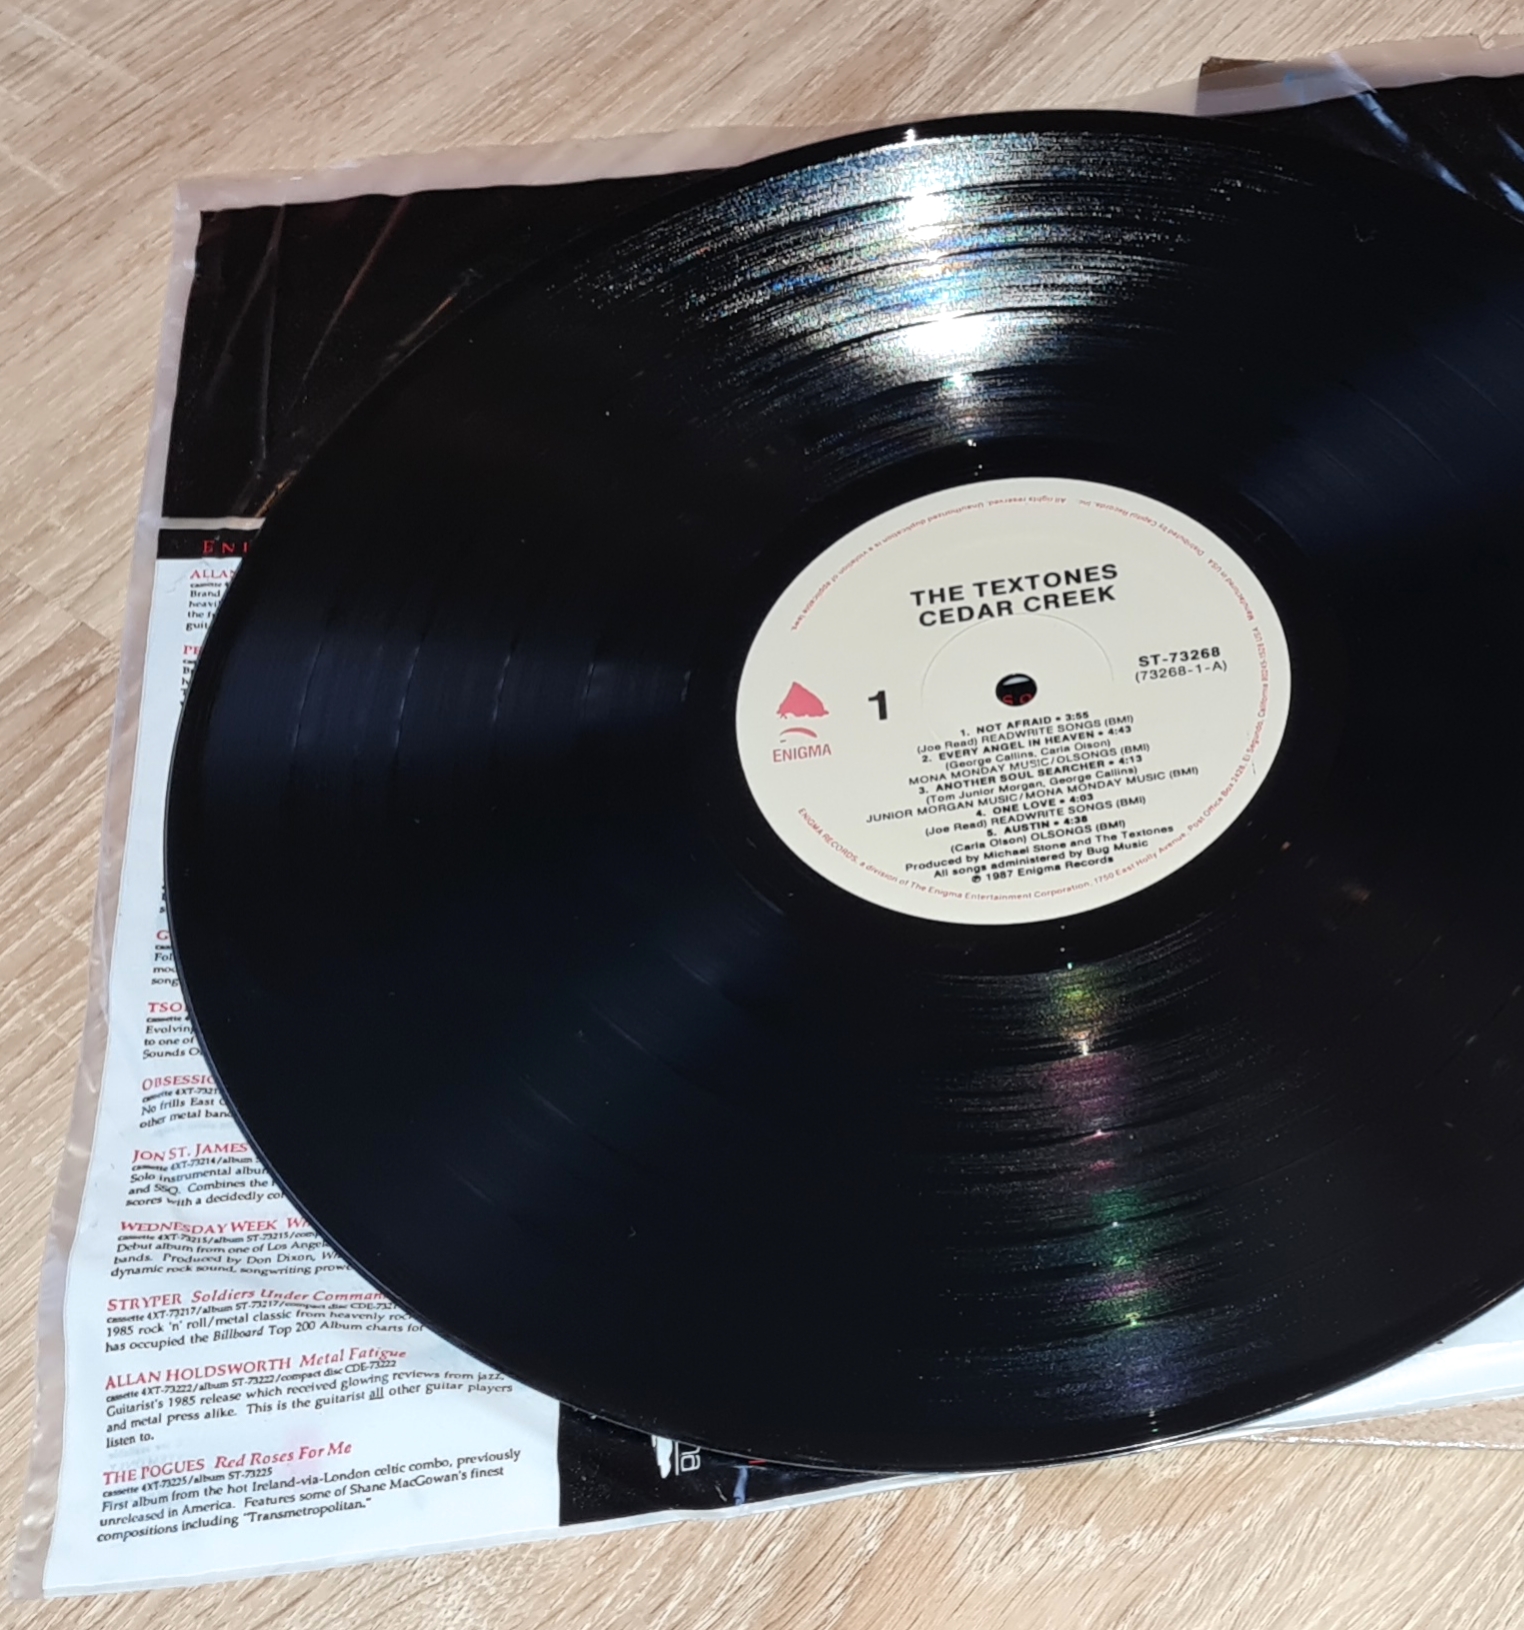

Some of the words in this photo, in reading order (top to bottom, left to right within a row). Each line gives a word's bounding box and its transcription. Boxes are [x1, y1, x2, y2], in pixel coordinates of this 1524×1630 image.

[910, 585, 964, 606] THE
[973, 563, 1117, 597] TEXTONES
[919, 600, 1013, 627] CEDAR
[1023, 585, 1114, 612] CREEK
[1135, 660, 1227, 683] (73268-1-A)
[1138, 646, 1220, 667] ST-73268
[868, 690, 887, 721] 1
[960, 728, 970, 737] 1.
[976, 722, 1002, 736] NOT
[1006, 715, 1052, 733] AFRAID
[1065, 710, 1090, 725] 3:55
[772, 743, 832, 763] ENIGMA
[916, 744, 942, 755] (Joe
[944, 737, 978, 751] Read)
[981, 725, 1053, 745] READWRITE
[1057, 719, 1101, 736] SONGS
[1104, 714, 1134, 729] (BMI)
[921, 754, 932, 763] 2.
[938, 745, 978, 761] EVERY
[982, 741, 1024, 754] ANGEL
[1028, 737, 1041, 747] IN
[1044, 730, 1094, 744] HEAVEN
[1107, 724, 1132, 735] 4:43
[908, 772, 947, 785] MONA
[950, 763, 1005, 780] MONDAY
[1009, 747, 1117, 773] MUSIC/OLSONGS
[1120, 742, 1150, 758] (BMI)
[945, 757, 992, 771] (George
[995, 751, 1037, 763] Callins,
[1040, 745, 1071, 759] Carla
[1073, 738, 1111, 754] Olson)
[918, 786, 929, 795] 3.
[935, 775, 996, 792] ANOTHER
[999, 770, 1034, 783] SOUL
[1037, 759, 1105, 777] SEARCHER
[1118, 754, 1143, 765] 4:13
[925, 793, 955, 805] (Tom
[958, 787, 994, 799] Junior
[998, 780, 1045, 794] Morgan,
[1049, 773, 1092, 787] George
[1095, 765, 1138, 782] Callins)
[866, 808, 913, 823] JUNIOR
[916, 800, 974, 815] MORGAN
[977, 787, 1063, 806] MUSIC/MONA
[1066, 777, 1121, 793] MONDAY
[1125, 771, 1165, 785] MUSIC
[1168, 766, 1199, 779] (BMI)
[975, 809, 986, 817] 4.
[992, 803, 1019, 815] ONE
[1022, 797, 1056, 811] LOVE
[1069, 792, 1094, 807] 4:03
[925, 825, 950, 837] (Joe
[953, 819, 987, 831] Read)
[990, 807, 1063, 826] READWRITE
[1067, 800, 1113, 817] SONGS
[1115, 795, 1146, 809] (BMI)
[986, 828, 997, 837] 5.
[1003, 820, 1050, 834] AUSTIN
[1063, 814, 1088, 827] 4:38
[905, 855, 962, 871] Produced
[965, 854, 979, 863] by
[983, 846, 1029, 860] Michael
[1032, 842, 1067, 853] Stone
[1069, 836, 1092, 847] and
[1095, 834, 1118, 843] The
[1121, 825, 1174, 839] Textones
[950, 841, 986, 854] (Carla
[989, 834, 1027, 847] Olson)
[1030, 824, 1092, 841] OLSONGS
[1095, 819, 1126, 832] (BMI)
[933, 868, 949, 878] All
[952, 862, 987, 876] songs
[990, 851, 1065, 870] administered
[1068, 849, 1083, 859] by
[1086, 845, 1110, 856] Bug
[1113, 839, 1148, 851] Music
[986, 869, 1013, 881] 1987
[1017, 864, 1061, 877] Enigma
[1064, 855, 1114, 869] Records
[131, 1149, 165, 1164] JON
[168, 1146, 191, 1160] ST.
[195, 1142, 248, 1157] JAMES
[121, 1221, 226, 1235] WEDNESDAY
[230, 1219, 277, 1232] WEEK
[107, 1293, 181, 1311] STRYPER
[191, 1288, 257, 1304] Soldiers
[258, 1288, 309, 1304] Under
[105, 1370, 161, 1390] ALLAN
[166, 1357, 290, 1381] HOLDSWORTH
[299, 1350, 344, 1369] Metal
[349, 1346, 407, 1360] Fatigue
[101, 1499, 129, 1512] First
[131, 1494, 169, 1508] album
[171, 1489, 200, 1502] from
[203, 1485, 223, 1497] the
[226, 1483, 248, 1494] hot
[252, 1468, 370, 1492] Ireland-via-London
[373, 1462, 406, 1476] celtic
[408, 1458, 452, 1472] combo,
[456, 1449, 521, 1469] previously
[102, 1468, 137, 1485] THE
[141, 1458, 205, 1480] POGUES
[214, 1453, 246, 1469] Red
[249, 1451, 294, 1466] Roses
[298, 1445, 325, 1460] For
[327, 1441, 352, 1456] Me
[99, 1508, 165, 1527] unreleased
[181, 1500, 235, 1515] America.
[244, 1494, 296, 1507] Features
[299, 1489, 331, 1502] some
[349, 1482, 387, 1495] Shane
[389, 1470, 467, 1489] MacGowan's
[470, 1466, 504, 1479] finest
[96, 1524, 178, 1542] compositions
[181, 1515, 239, 1531] including
